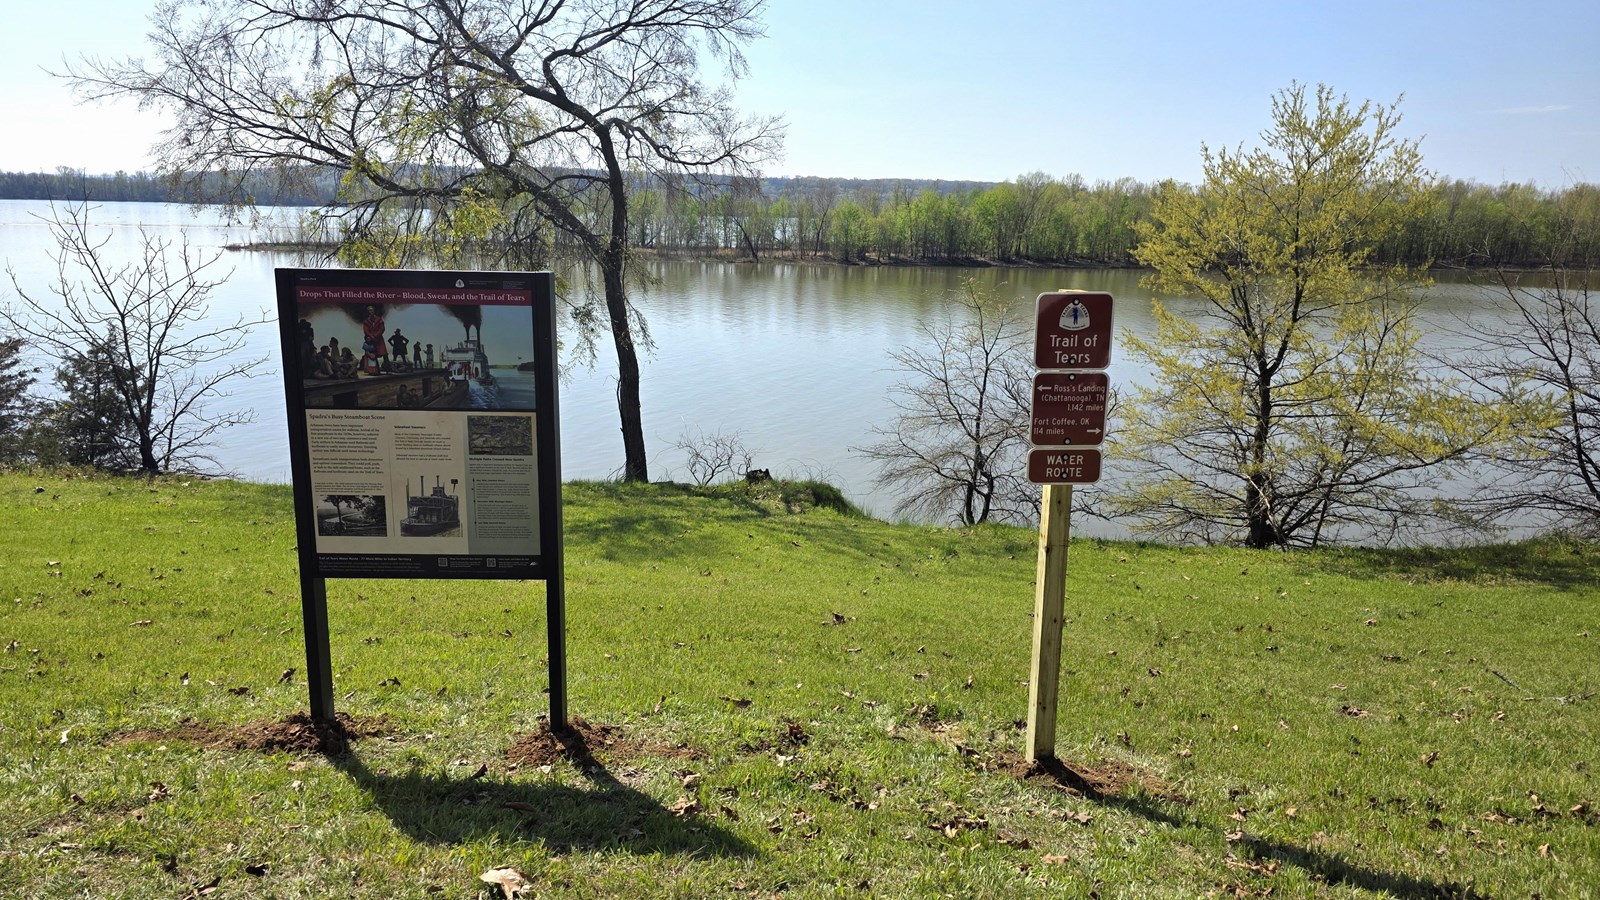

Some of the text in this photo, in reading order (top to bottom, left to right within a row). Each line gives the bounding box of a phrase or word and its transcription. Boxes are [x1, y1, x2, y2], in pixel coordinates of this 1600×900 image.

[300, 290, 322, 298] Drops
[1050, 334, 1098, 347] Trail of
[1055, 351, 1090, 363] Tears
[1078, 385, 1105, 393] Landing
